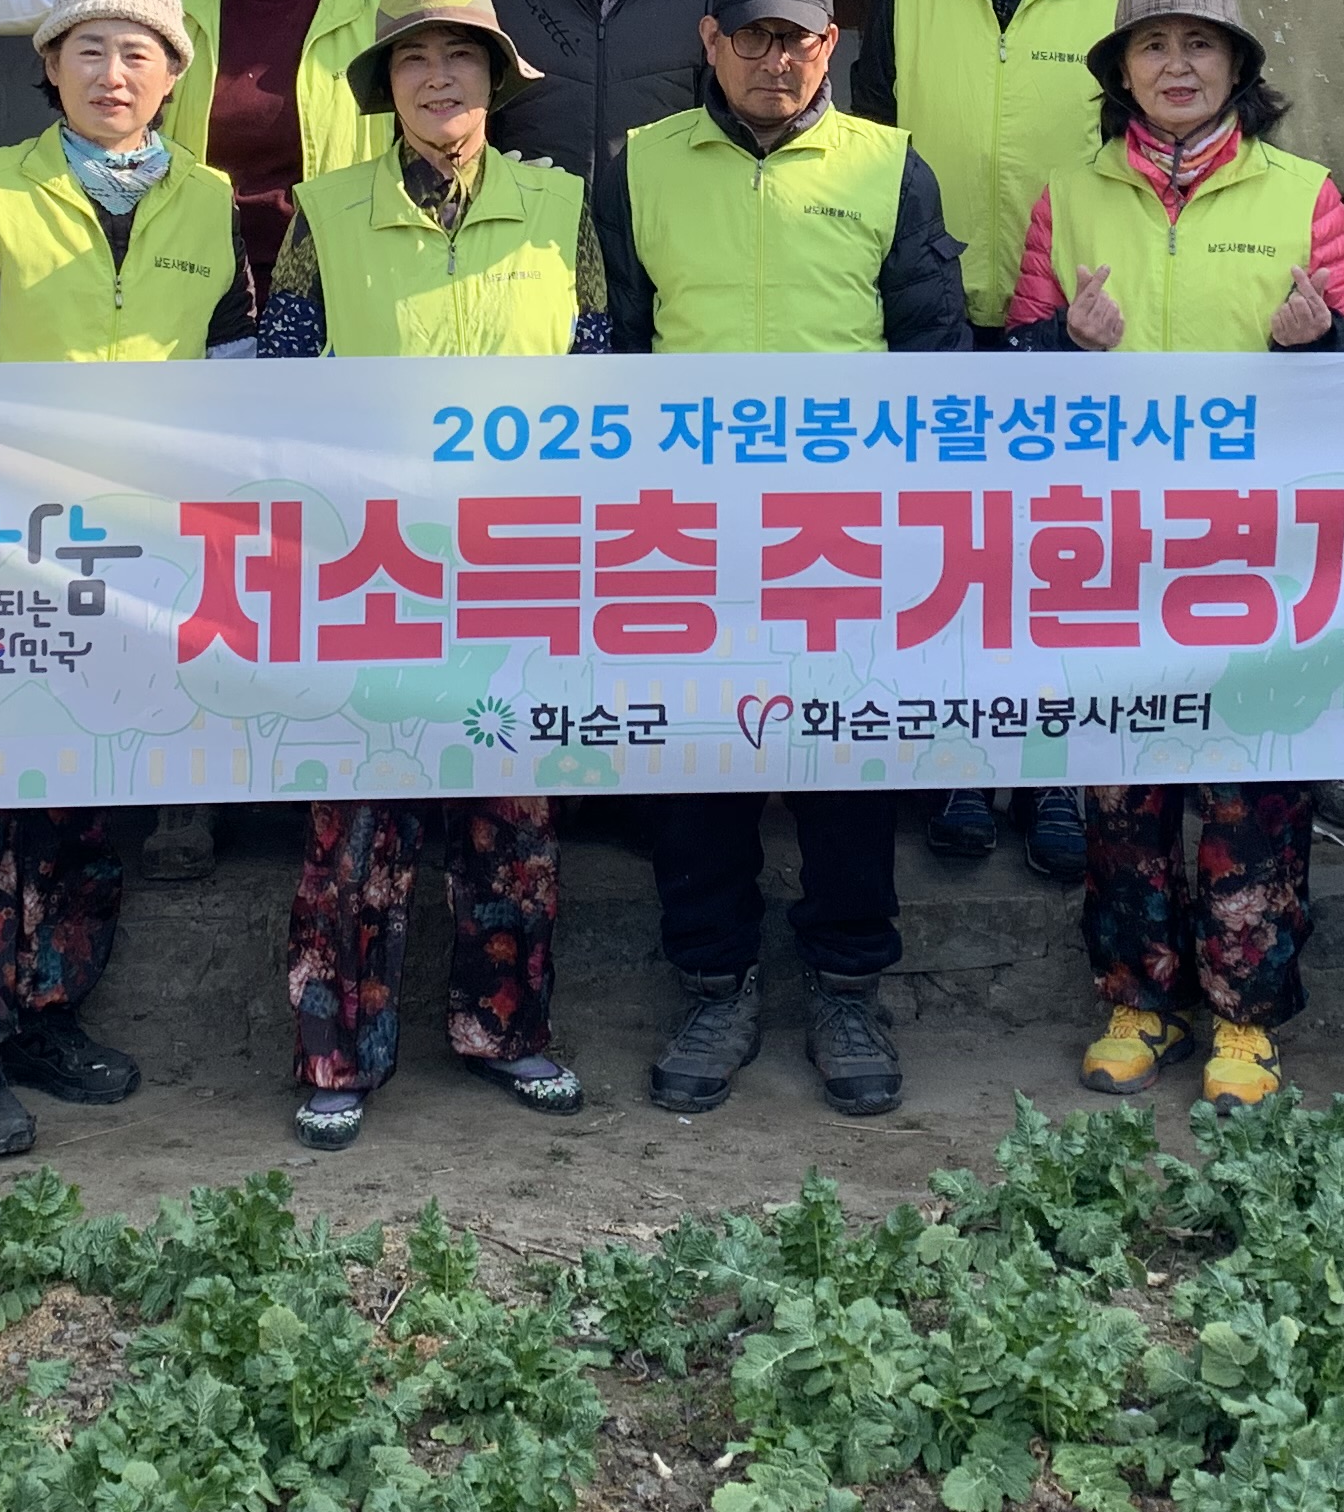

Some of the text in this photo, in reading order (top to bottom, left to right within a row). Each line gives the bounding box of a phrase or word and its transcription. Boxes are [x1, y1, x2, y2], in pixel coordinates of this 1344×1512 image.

[154, 254, 211, 277] 남도사랑봉사단
[1208, 242, 1277, 257] 남도사랑봉사단
[432, 394, 1256, 465] 2025 자원봉사활성화사업
[177, 489, 718, 665] 저소득층
[529, 702, 669, 746] 화순군
[801, 692, 1213, 742] 화순군자원봉사센터
